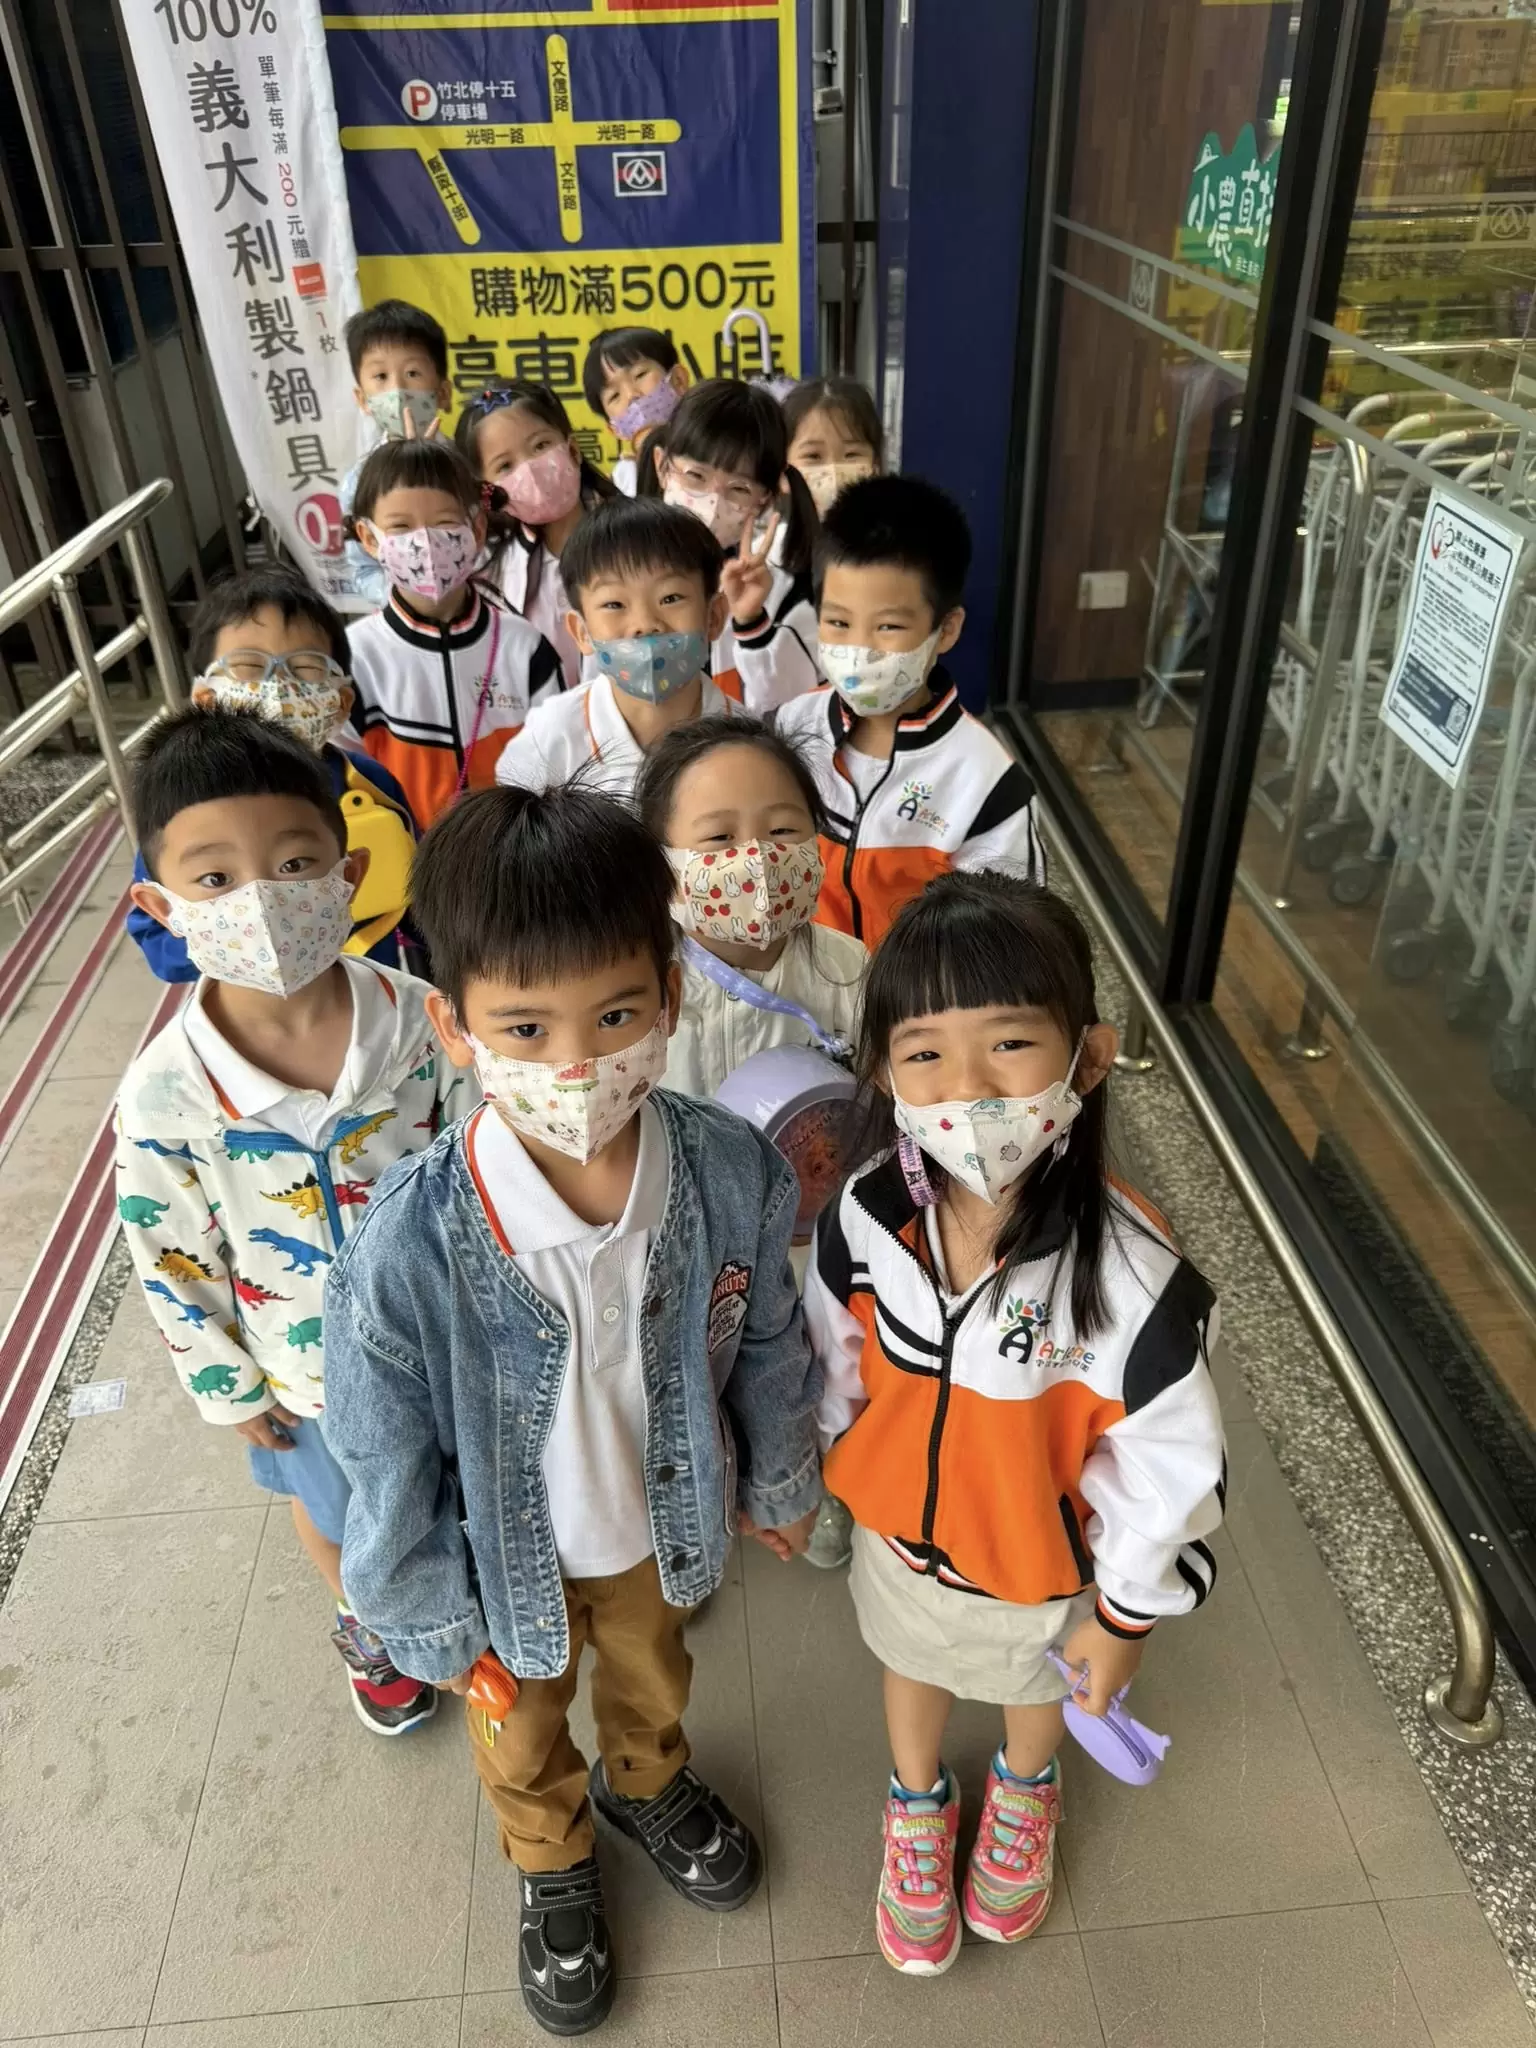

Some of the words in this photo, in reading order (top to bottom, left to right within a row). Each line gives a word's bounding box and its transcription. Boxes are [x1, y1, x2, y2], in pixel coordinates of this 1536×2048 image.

[154, 0, 277, 44] 100%
[436, 80, 517, 99] 竹北停十五
[551, 61, 568, 111] 文信路
[440, 103, 488, 121] 停車場
[466, 128, 524, 145] 光明一路
[597, 123, 655, 141] 光明一路
[187, 59, 338, 492] 義大利製鍋具
[470, 261, 775, 317] 購物滿500元
